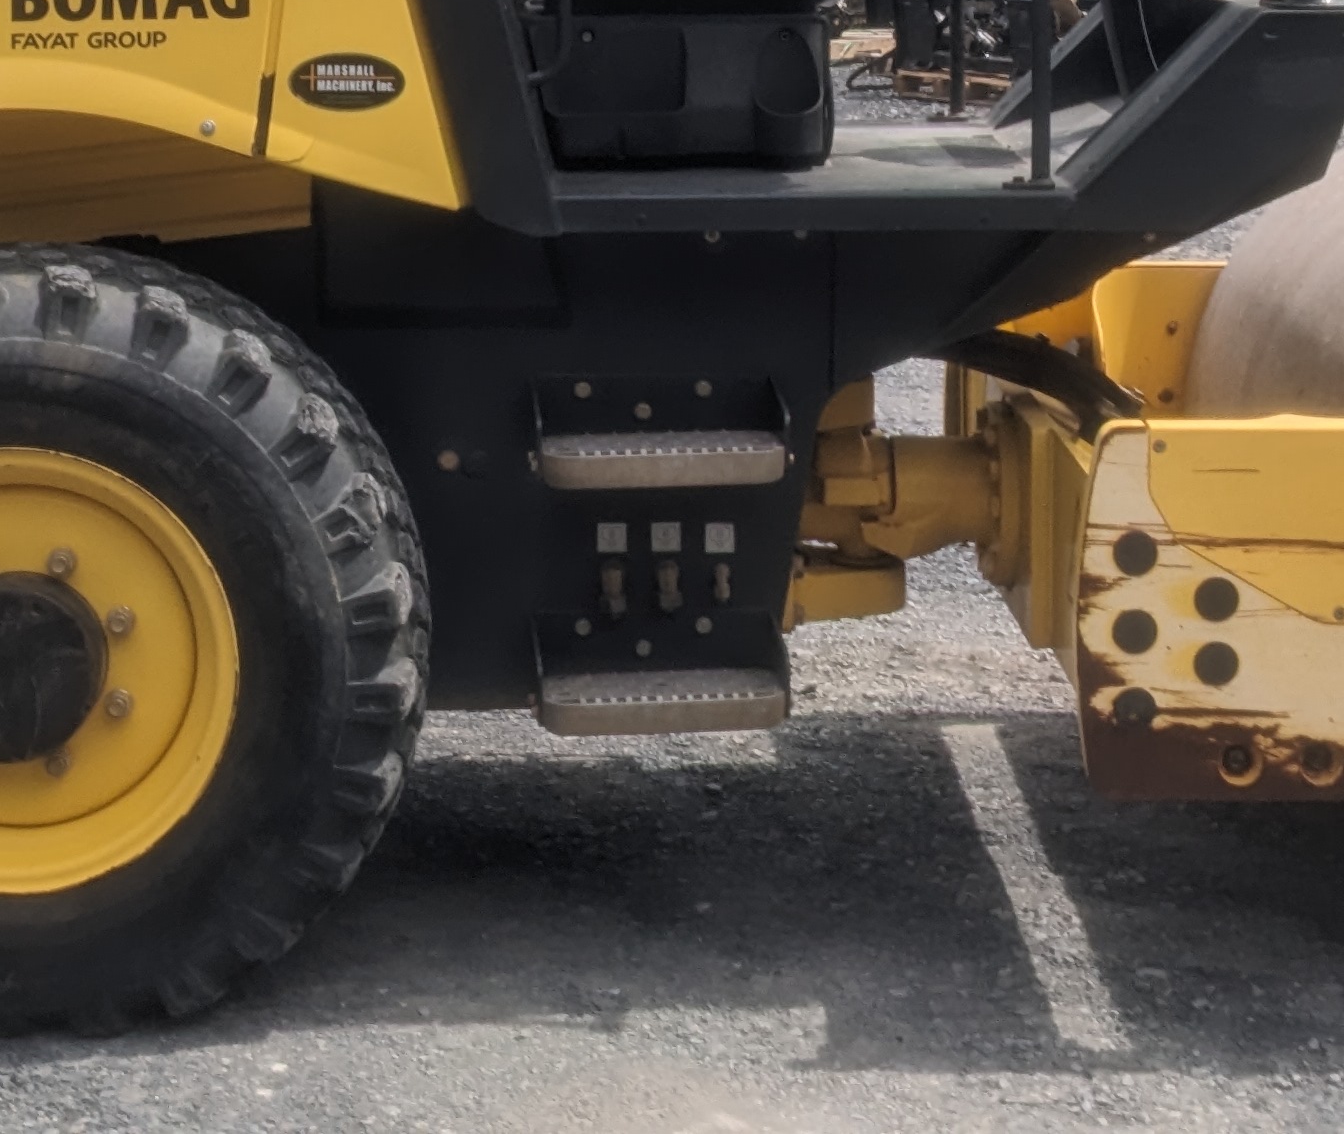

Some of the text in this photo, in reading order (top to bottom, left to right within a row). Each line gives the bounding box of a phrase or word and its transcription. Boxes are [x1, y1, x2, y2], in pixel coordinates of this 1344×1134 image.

[10, 30, 168, 50] FAYAT GROUP
[316, 64, 375, 76] MARSHALL
[316, 80, 376, 93] MACHINERY,
